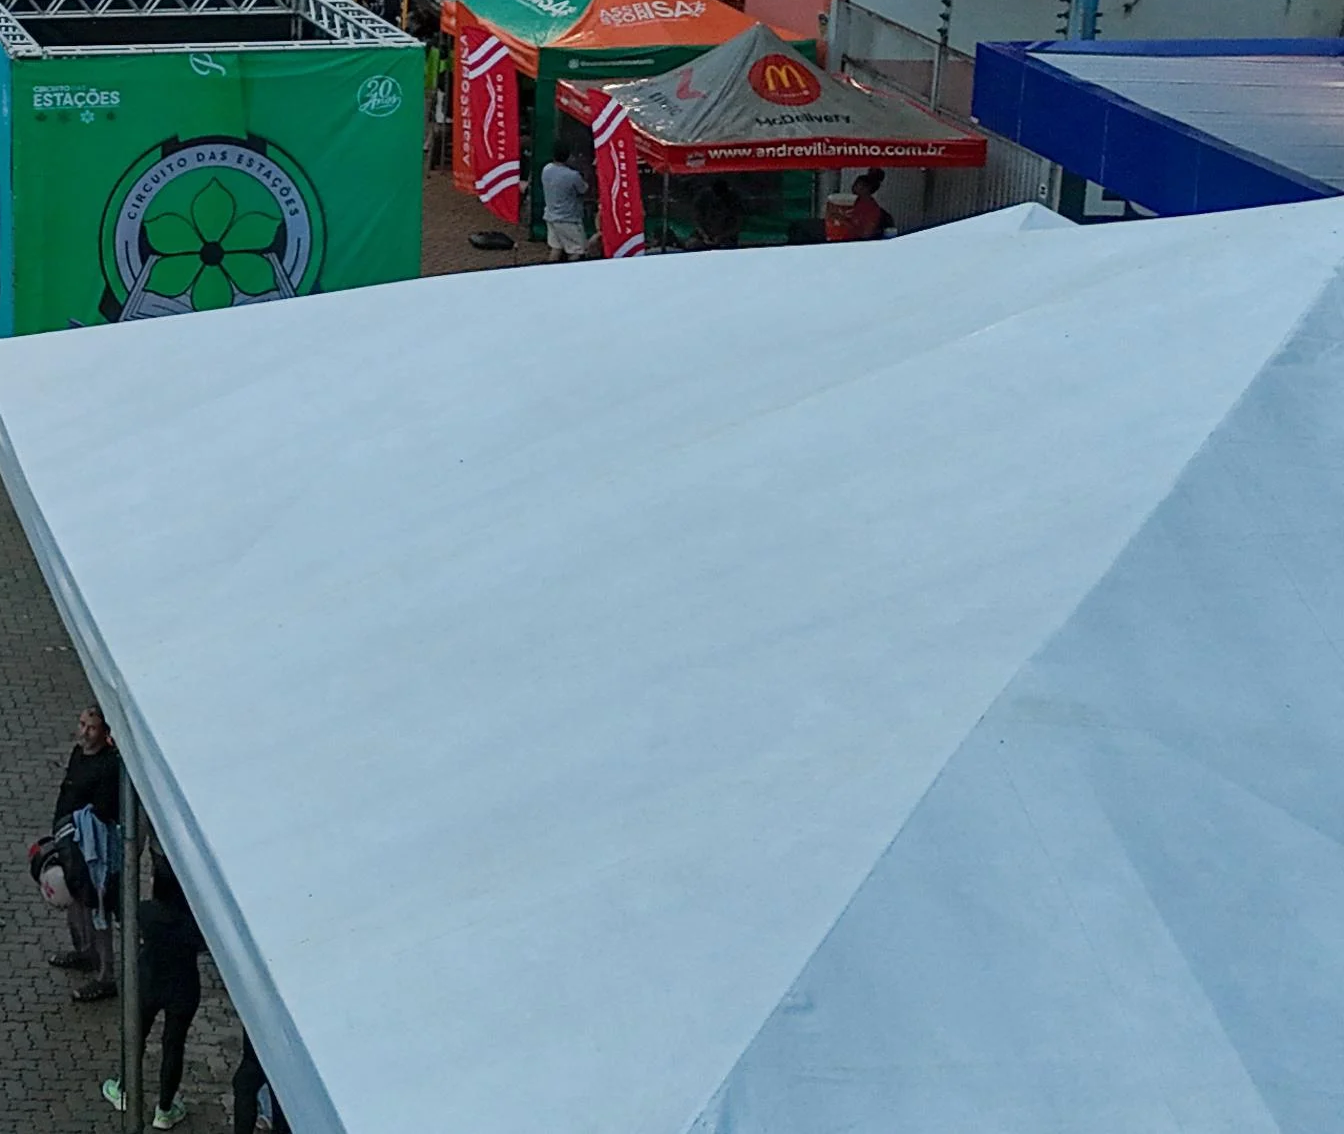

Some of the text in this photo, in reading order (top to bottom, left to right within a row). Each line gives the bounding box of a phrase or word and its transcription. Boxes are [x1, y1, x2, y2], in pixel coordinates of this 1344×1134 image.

[33, 88, 121, 108] ESTAÇÕES
[365, 79, 393, 99] 20
[496, 73, 506, 161] VILLARINHO
[755, 113, 851, 127] McDelivery
[708, 142, 946, 159] www.andrevillarinho.com.br
[127, 151, 300, 220] CIRCUITO DAS ESTAÇÕES
